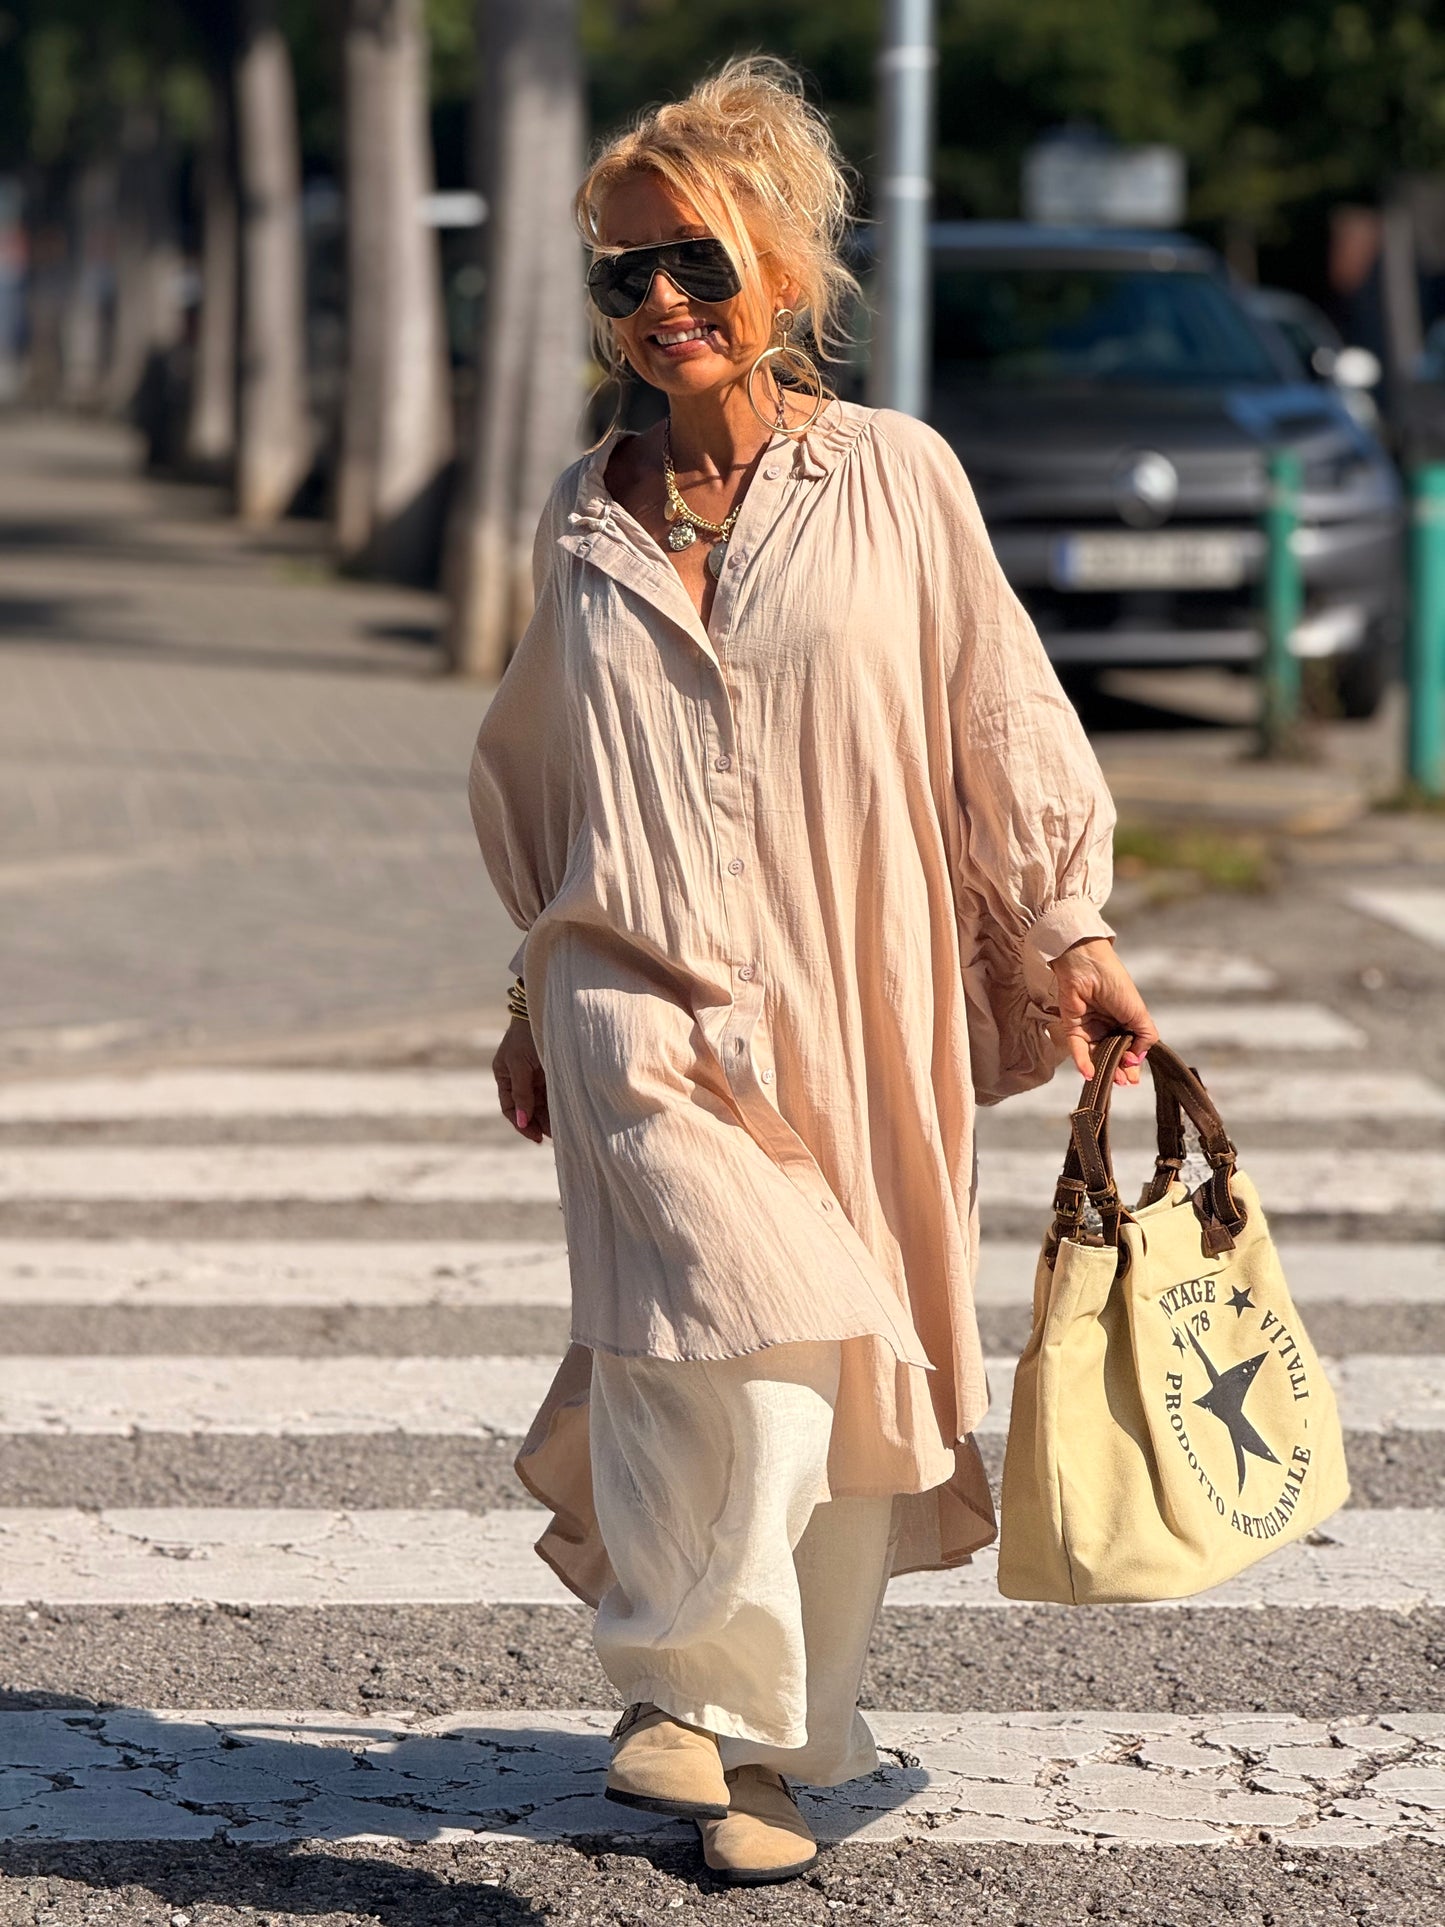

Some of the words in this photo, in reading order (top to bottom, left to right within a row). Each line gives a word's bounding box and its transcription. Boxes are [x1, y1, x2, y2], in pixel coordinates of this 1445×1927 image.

[1260, 1310, 1309, 1401] ITALIA
[1165, 1371, 1226, 1516] PRODOTTO
[1231, 1445, 1312, 1539] ARTIGIANALE
